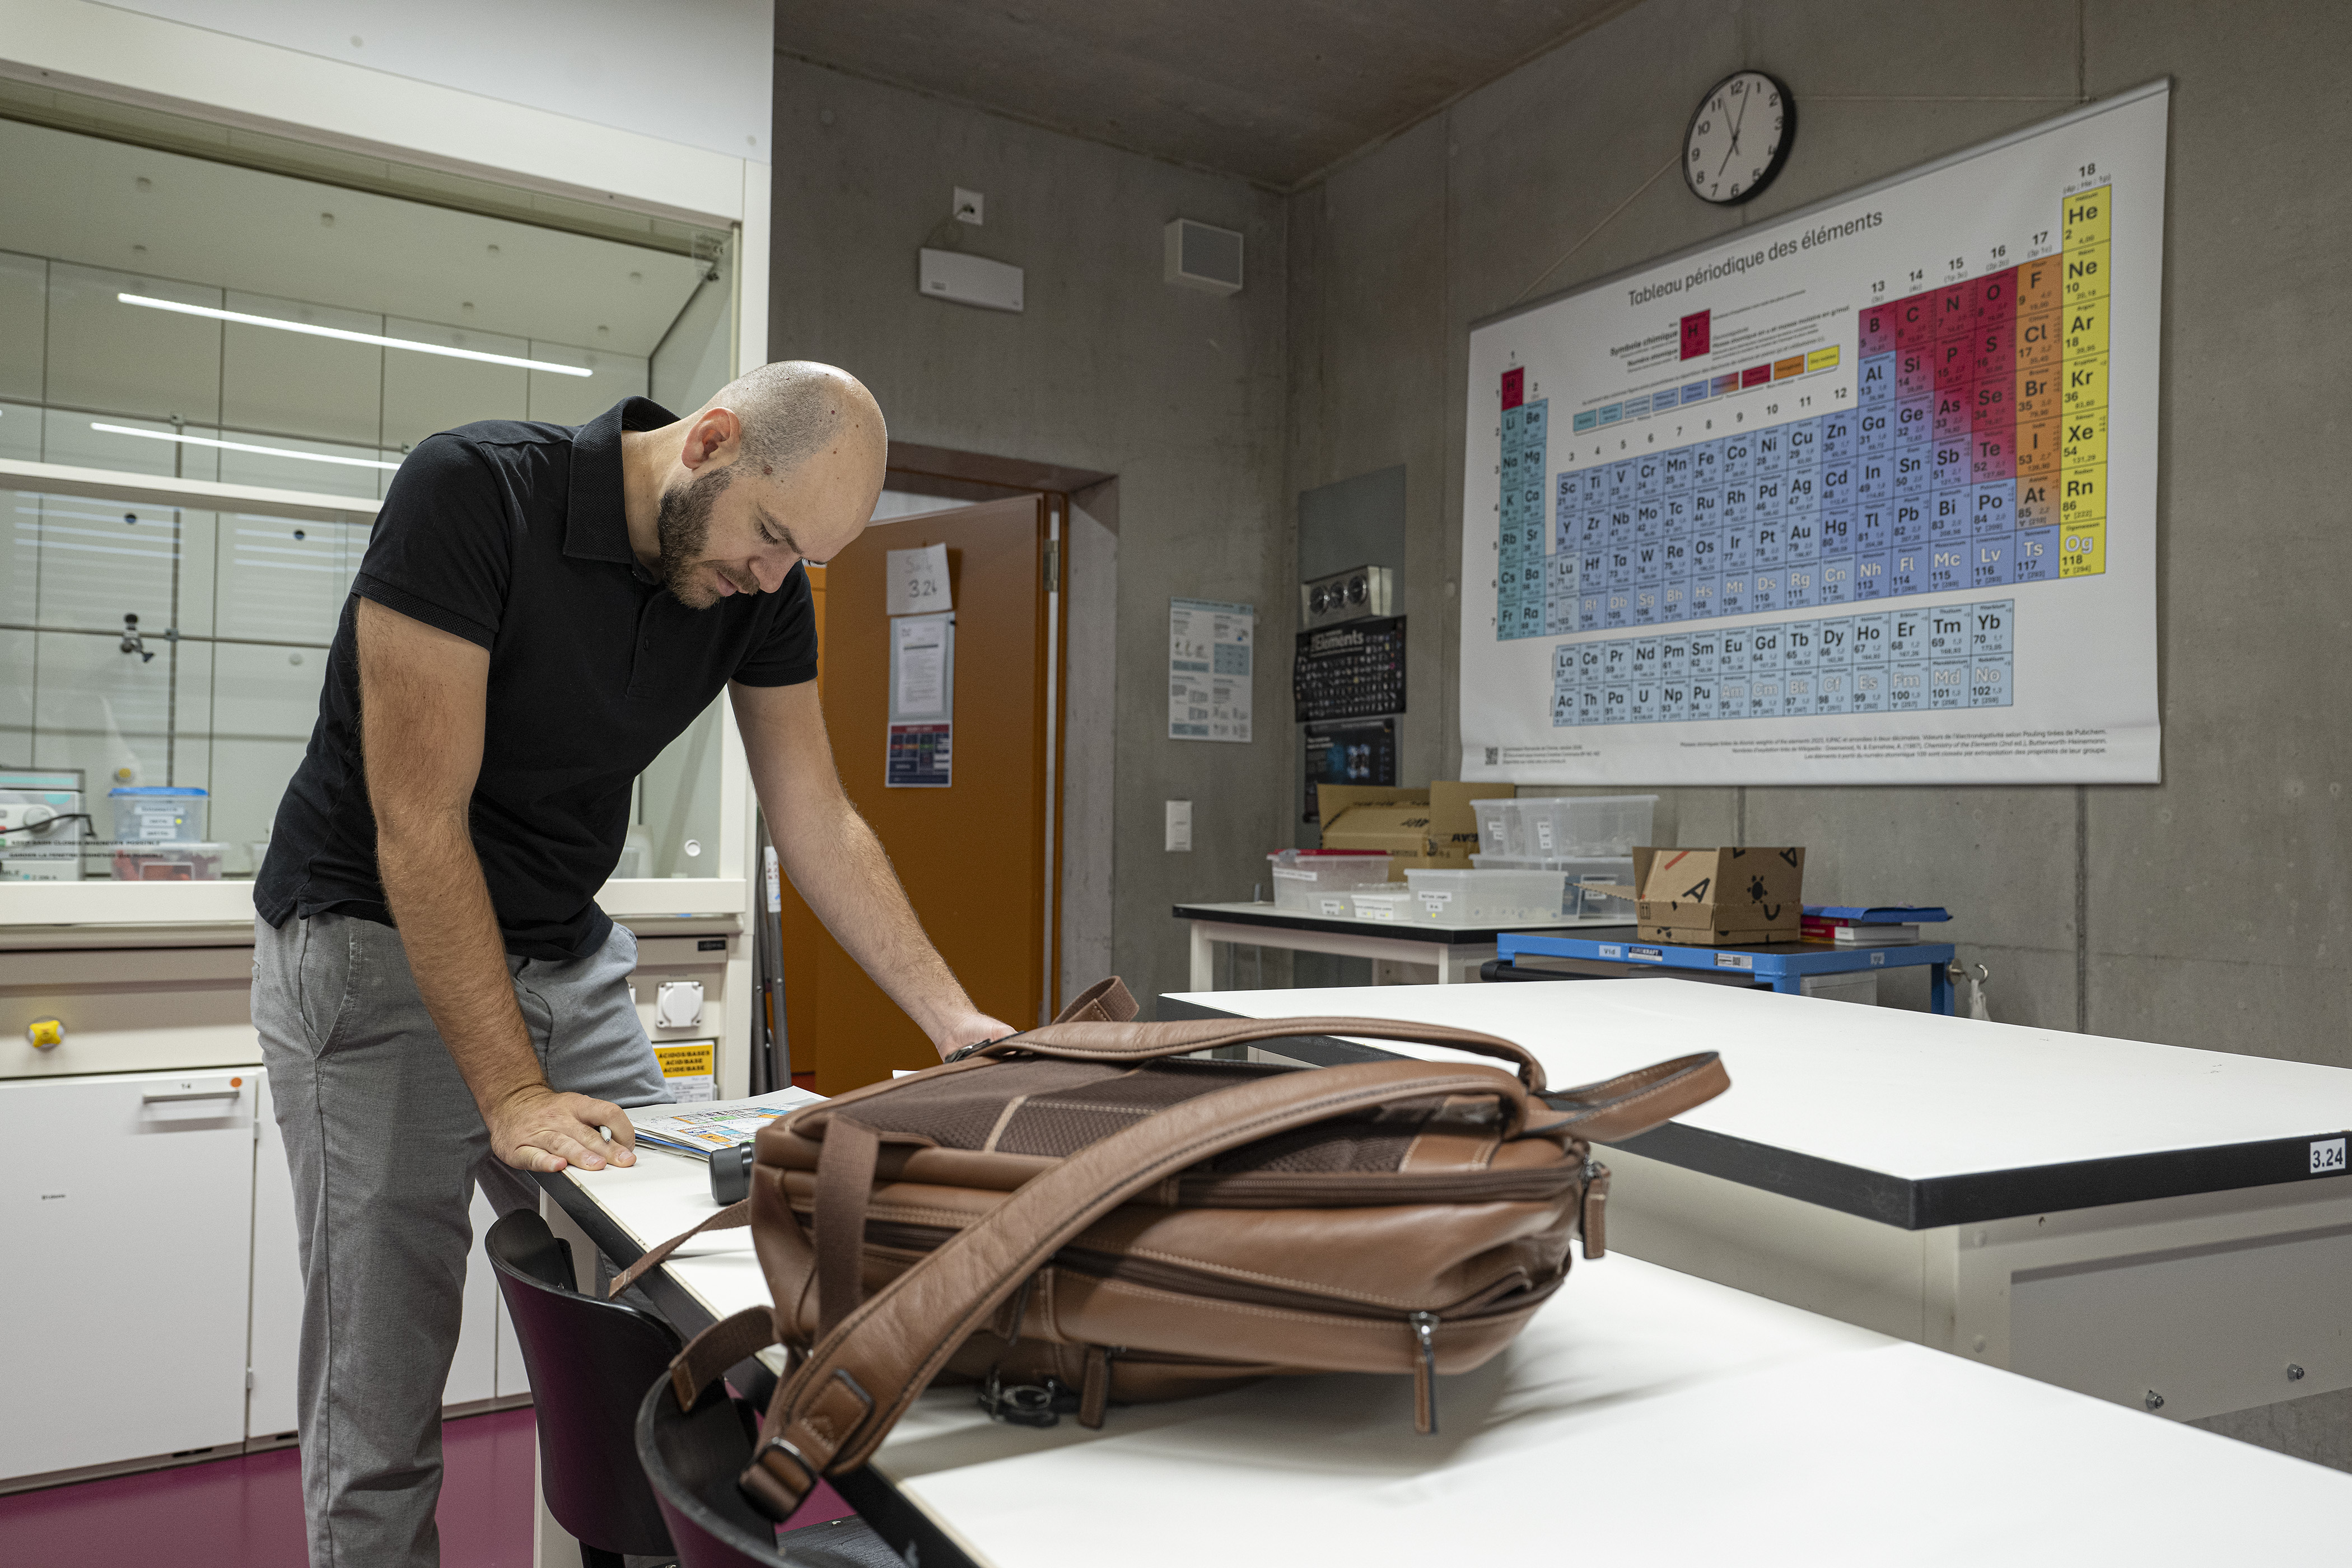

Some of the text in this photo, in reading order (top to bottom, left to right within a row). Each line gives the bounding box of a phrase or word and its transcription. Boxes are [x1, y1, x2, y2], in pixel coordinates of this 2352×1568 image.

[1730, 80, 1743, 96] 12
[1757, 82, 1761, 94] 1
[1711, 97, 1721, 112] 11
[1698, 120, 1710, 136] 10
[1691, 147, 1700, 162] 9
[1696, 170, 1705, 184] 8
[2079, 163, 2096, 177] 18
[1711, 182, 1718, 197] 7
[2069, 206, 2098, 224] He
[2033, 230, 2048, 245] 17
[2065, 229, 2072, 240] 2
[1628, 279, 1682, 306] Tableau
[1686, 251, 1764, 292] périodique
[1768, 238, 1798, 260] des
[1802, 211, 1884, 250] éléments
[1991, 245, 2005, 259] 16
[1949, 257, 1963, 270] 15
[2069, 261, 2098, 279] Ne
[1910, 269, 1923, 281] 14
[2031, 271, 2042, 289] F
[1872, 280, 1885, 293] 13
[1987, 284, 2000, 301] O
[2066, 282, 2079, 293] 10
[1947, 296, 1959, 312] N
[1906, 307, 1919, 323] C
[1870, 318, 1880, 333] B
[2071, 316, 2094, 334] Ar
[2025, 324, 2047, 343] Cl
[1986, 336, 1998, 352] S
[2066, 337, 2079, 348] 18
[1947, 347, 1958, 363] P
[2019, 347, 2032, 358] 17
[1905, 356, 1920, 373] Si
[1866, 365, 1883, 382] Al
[2072, 370, 2094, 388] Kr
[1835, 387, 1847, 399] 12
[2025, 380, 2047, 397] Br
[1799, 395, 1813, 407] 11
[1978, 390, 2003, 406] Se
[2065, 391, 2078, 403] 36
[1766, 403, 1779, 416] 10
[1939, 399, 1961, 416] As
[1901, 408, 1924, 423] Ge
[1862, 416, 1886, 431] Ga
[1792, 431, 1813, 446] Cu
[1827, 424, 1846, 439] Zn
[2068, 425, 2093, 443] Xe
[1762, 437, 1777, 453] Ni
[2033, 433, 2038, 449] I
[1727, 446, 1747, 460] Co
[1937, 449, 1959, 466] Sb
[1980, 442, 2001, 458] Te
[2064, 446, 2077, 458] 54
[1667, 458, 1687, 473] Mn
[1698, 452, 1715, 466] Fe
[1900, 458, 1921, 474] Sn
[2019, 454, 2033, 465] 53
[1617, 470, 1625, 483] V
[1641, 464, 1655, 478] Cr
[1826, 469, 1847, 486] Cd
[1865, 465, 1880, 480] In
[1560, 482, 1576, 495] Sc
[1591, 477, 1601, 489] Ti
[1791, 478, 1812, 495] Ag
[2068, 480, 2094, 497] Rn
[1727, 490, 1746, 505] Rh
[1759, 483, 1777, 499] Pd
[2024, 487, 2046, 504] At
[1669, 502, 1683, 515] Tc
[1697, 497, 1715, 511] Ru
[1939, 498, 1956, 516] Bi
[1978, 494, 2003, 511] Po
[2062, 500, 2076, 512] 86
[1612, 512, 1630, 526] Nb
[1639, 508, 1658, 521] Mo
[1865, 512, 1879, 528] Tl
[1898, 506, 1919, 522] Pb
[1563, 521, 1571, 534] Y
[1587, 517, 1600, 531] Zr
[1824, 519, 1847, 536] Hg
[1760, 530, 1775, 544] Pt
[1791, 525, 1811, 540] Au
[1696, 540, 1714, 554] Os
[1731, 536, 1741, 549] Ir
[2024, 542, 2044, 557] Ts
[2065, 535, 2094, 555] Og
[1641, 549, 1654, 563] W
[1667, 545, 1684, 559] Re
[1981, 548, 2001, 563] Lv
[1585, 558, 1600, 571] Hf
[1613, 553, 1627, 567] Ta
[1900, 557, 1915, 572] Fl
[1934, 552, 1961, 568] Mc
[2018, 560, 2037, 571] 117
[2062, 554, 2083, 566] 118
[1824, 568, 1846, 582] Cn
[1860, 562, 1882, 578] Nh
[1975, 566, 1995, 576] 116
[1757, 576, 1776, 591] Ds
[1791, 572, 1810, 588] Rg
[1897, 622, 1915, 638] Er
[1933, 618, 1961, 635] Tm
[1978, 614, 2000, 631] Yb
[1790, 632, 1809, 647] Tb
[1824, 629, 1844, 647] Dy
[1858, 626, 1880, 641] Ho
[1691, 641, 1714, 656] Sm
[1725, 638, 1743, 654] Eu
[1755, 634, 1777, 651] Gd
[1582, 651, 1598, 665] Ce
[1610, 649, 1623, 663] Pr
[1636, 646, 1655, 661] Nd
[1663, 645, 1684, 659] Pm
[1560, 654, 1574, 668] La
[1892, 672, 1921, 688] Fm
[1934, 669, 1961, 686] Md
[1975, 666, 2001, 684] No
[1608, 691, 1624, 705] Pa
[1639, 689, 1649, 703] U
[1664, 688, 1683, 704] Np
[1693, 686, 1710, 700] Pu
[1972, 686, 1991, 697] 102
[1557, 695, 1574, 708] Ac
[1584, 693, 1597, 706] Th
[2313, 1146, 2343, 1168] 3.24
